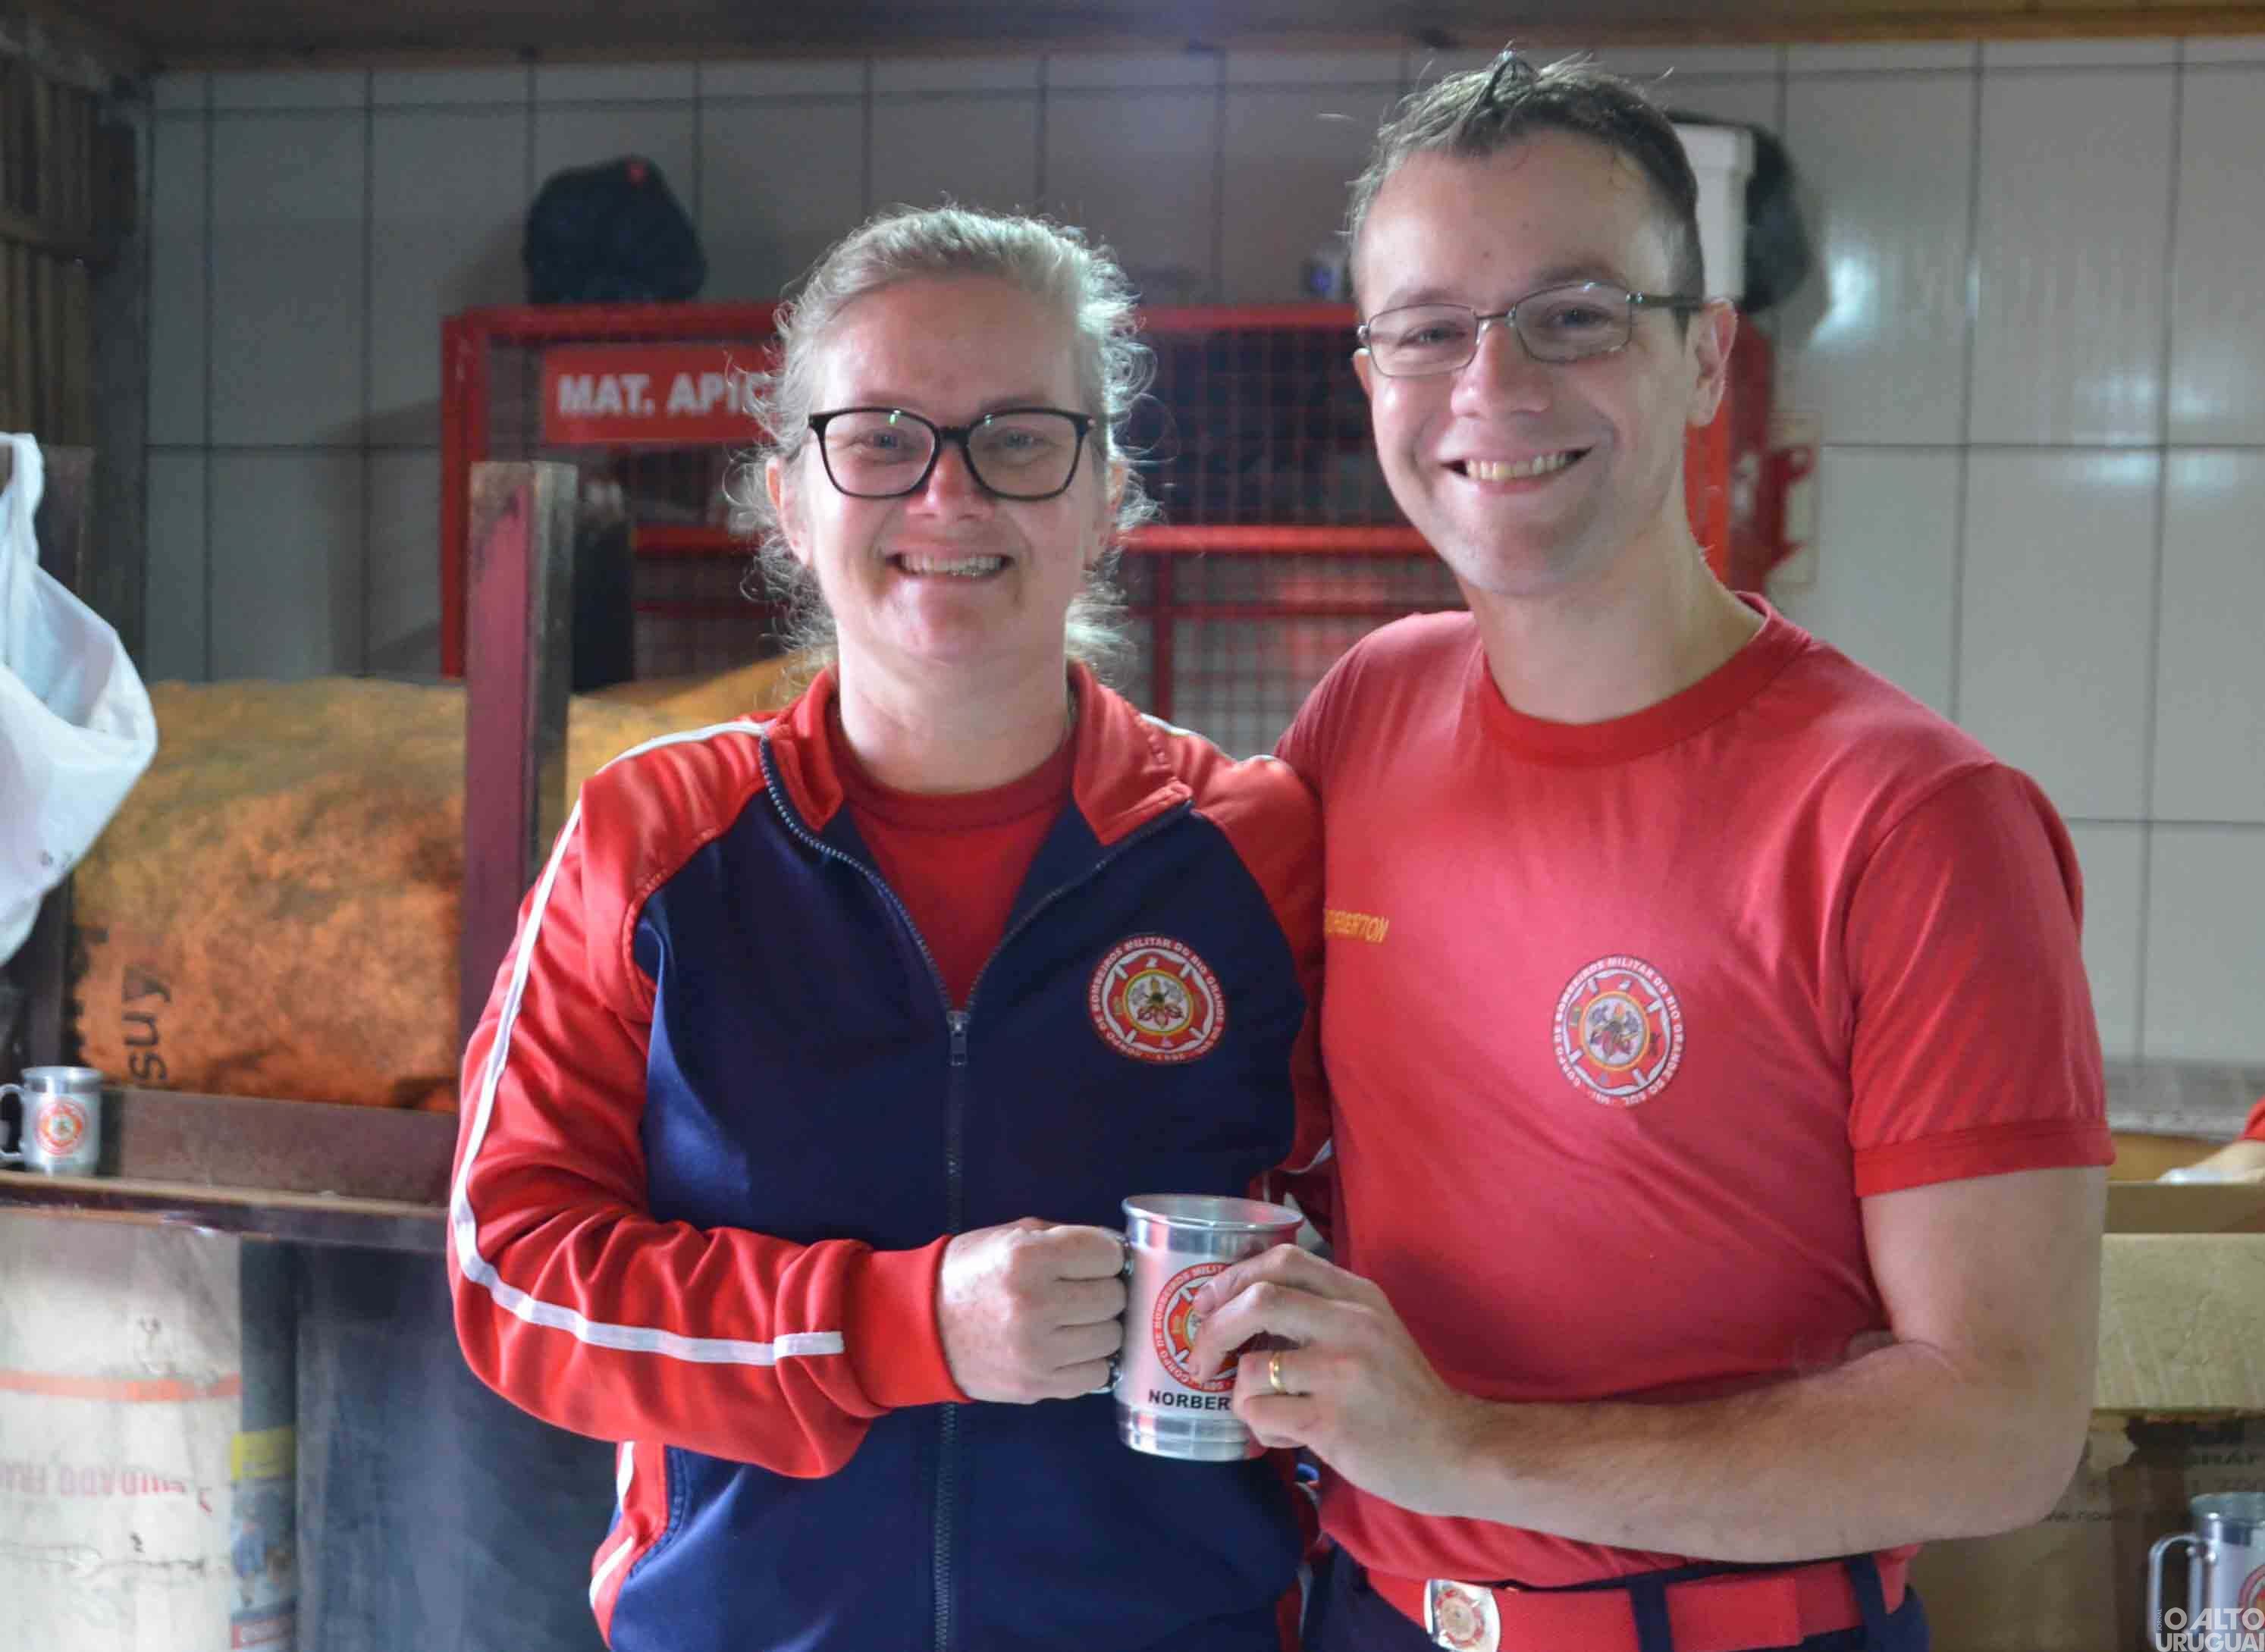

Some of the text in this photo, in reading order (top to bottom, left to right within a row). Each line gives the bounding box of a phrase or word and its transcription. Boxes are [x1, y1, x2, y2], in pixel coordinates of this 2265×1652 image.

[557, 373, 656, 416] MAT.
[1124, 936, 1172, 951] MILITAR
[1608, 957, 1655, 980] MILITAR
[1149, 1389, 1231, 1411] NORBER
